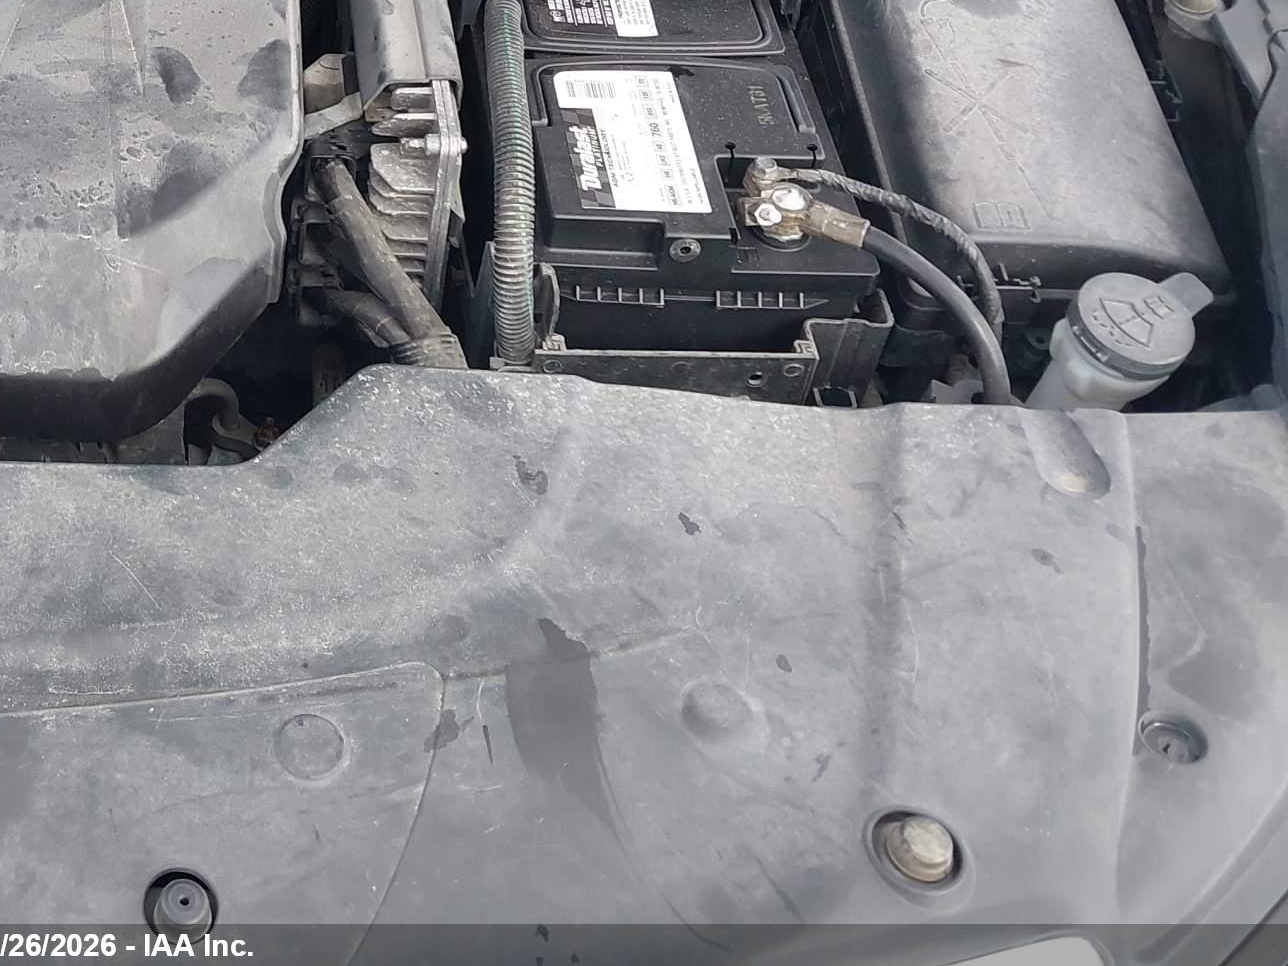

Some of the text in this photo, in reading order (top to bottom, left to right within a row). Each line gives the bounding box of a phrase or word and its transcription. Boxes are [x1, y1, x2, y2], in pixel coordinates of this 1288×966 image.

[587, 127, 603, 166] PLATINUM
[649, 122, 661, 136] 760
[568, 125, 602, 190] Duralast
